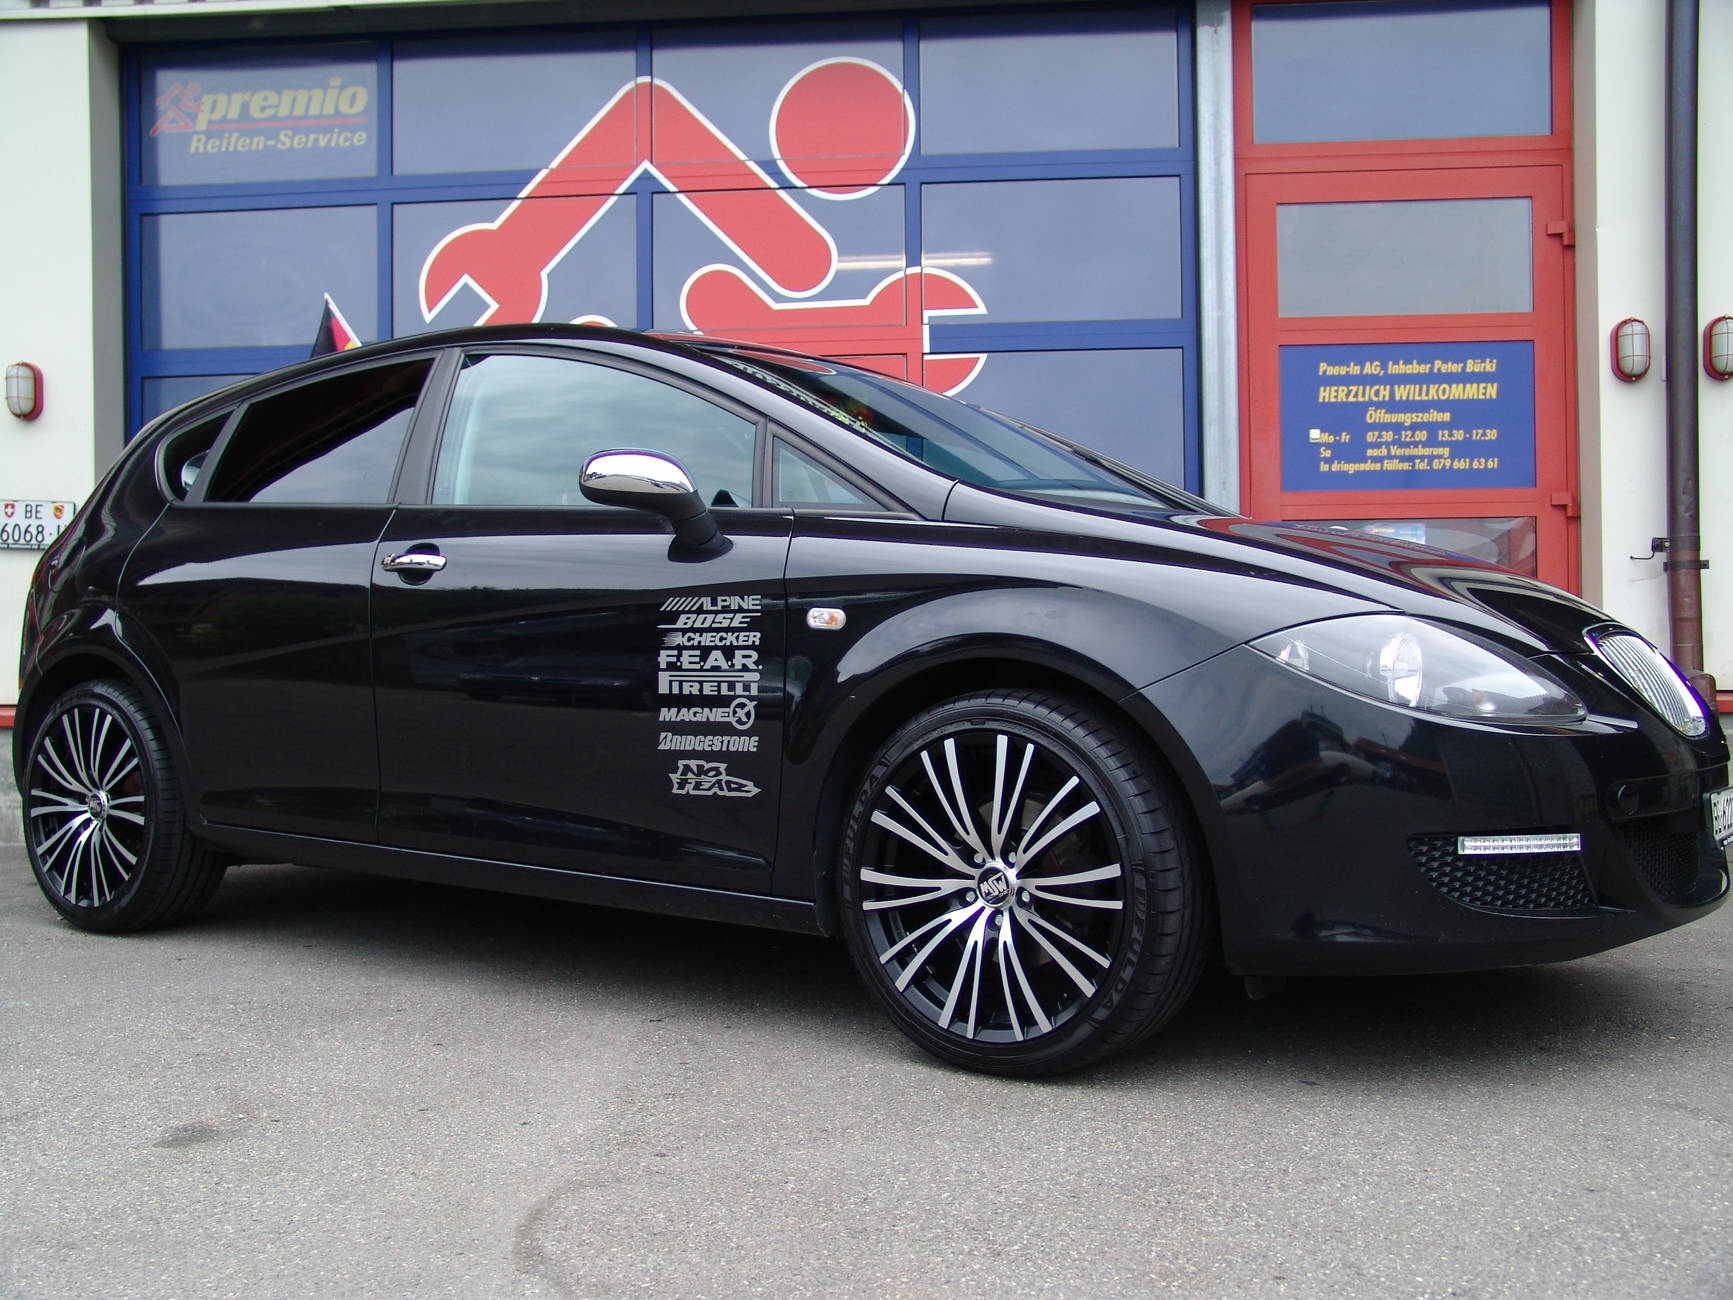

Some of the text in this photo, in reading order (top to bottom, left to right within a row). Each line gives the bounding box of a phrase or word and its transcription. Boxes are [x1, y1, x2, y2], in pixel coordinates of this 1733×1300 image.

[195, 77, 369, 131] premio
[189, 128, 367, 154] Reifen-Service
[1363, 361, 1385, 376] AG,
[1388, 360, 1431, 374] Inhaber
[1434, 360, 1464, 373] Peter
[1466, 358, 1497, 372] Bürki
[1319, 383, 1498, 402] HERZLICH WILLKOMMEN
[1366, 407, 1450, 426] Öffnungszeiten
[1320, 432, 1334, 443] Mo
[1341, 431, 1351, 442] Fr
[1366, 431, 1393, 442] 07.30
[1401, 430, 1427, 441] 12.00
[1438, 430, 1464, 440] 13.30
[1472, 429, 1498, 440] 17.30
[1320, 444, 1450, 458] Sa nach Vereinbarung
[1331, 460, 1381, 474] dringenden
[1415, 458, 1430, 470] Tel.
[1433, 458, 1451, 469] 079
[1453, 458, 1470, 469] 661
[1472, 458, 1485, 469] 63
[1487, 458, 1498, 468] 61
[25, 504, 43, 519] BE
[692, 595, 762, 610] ALPINE
[657, 613, 761, 628] BOSE
[682, 632, 761, 646] CHECKER
[658, 672, 761, 696] PIRELLI
[659, 698, 758, 730] MAGNEX
[657, 732, 759, 752] BRIDGESTONE
[679, 761, 725, 778] NO
[980, 871, 1008, 898] MSW
